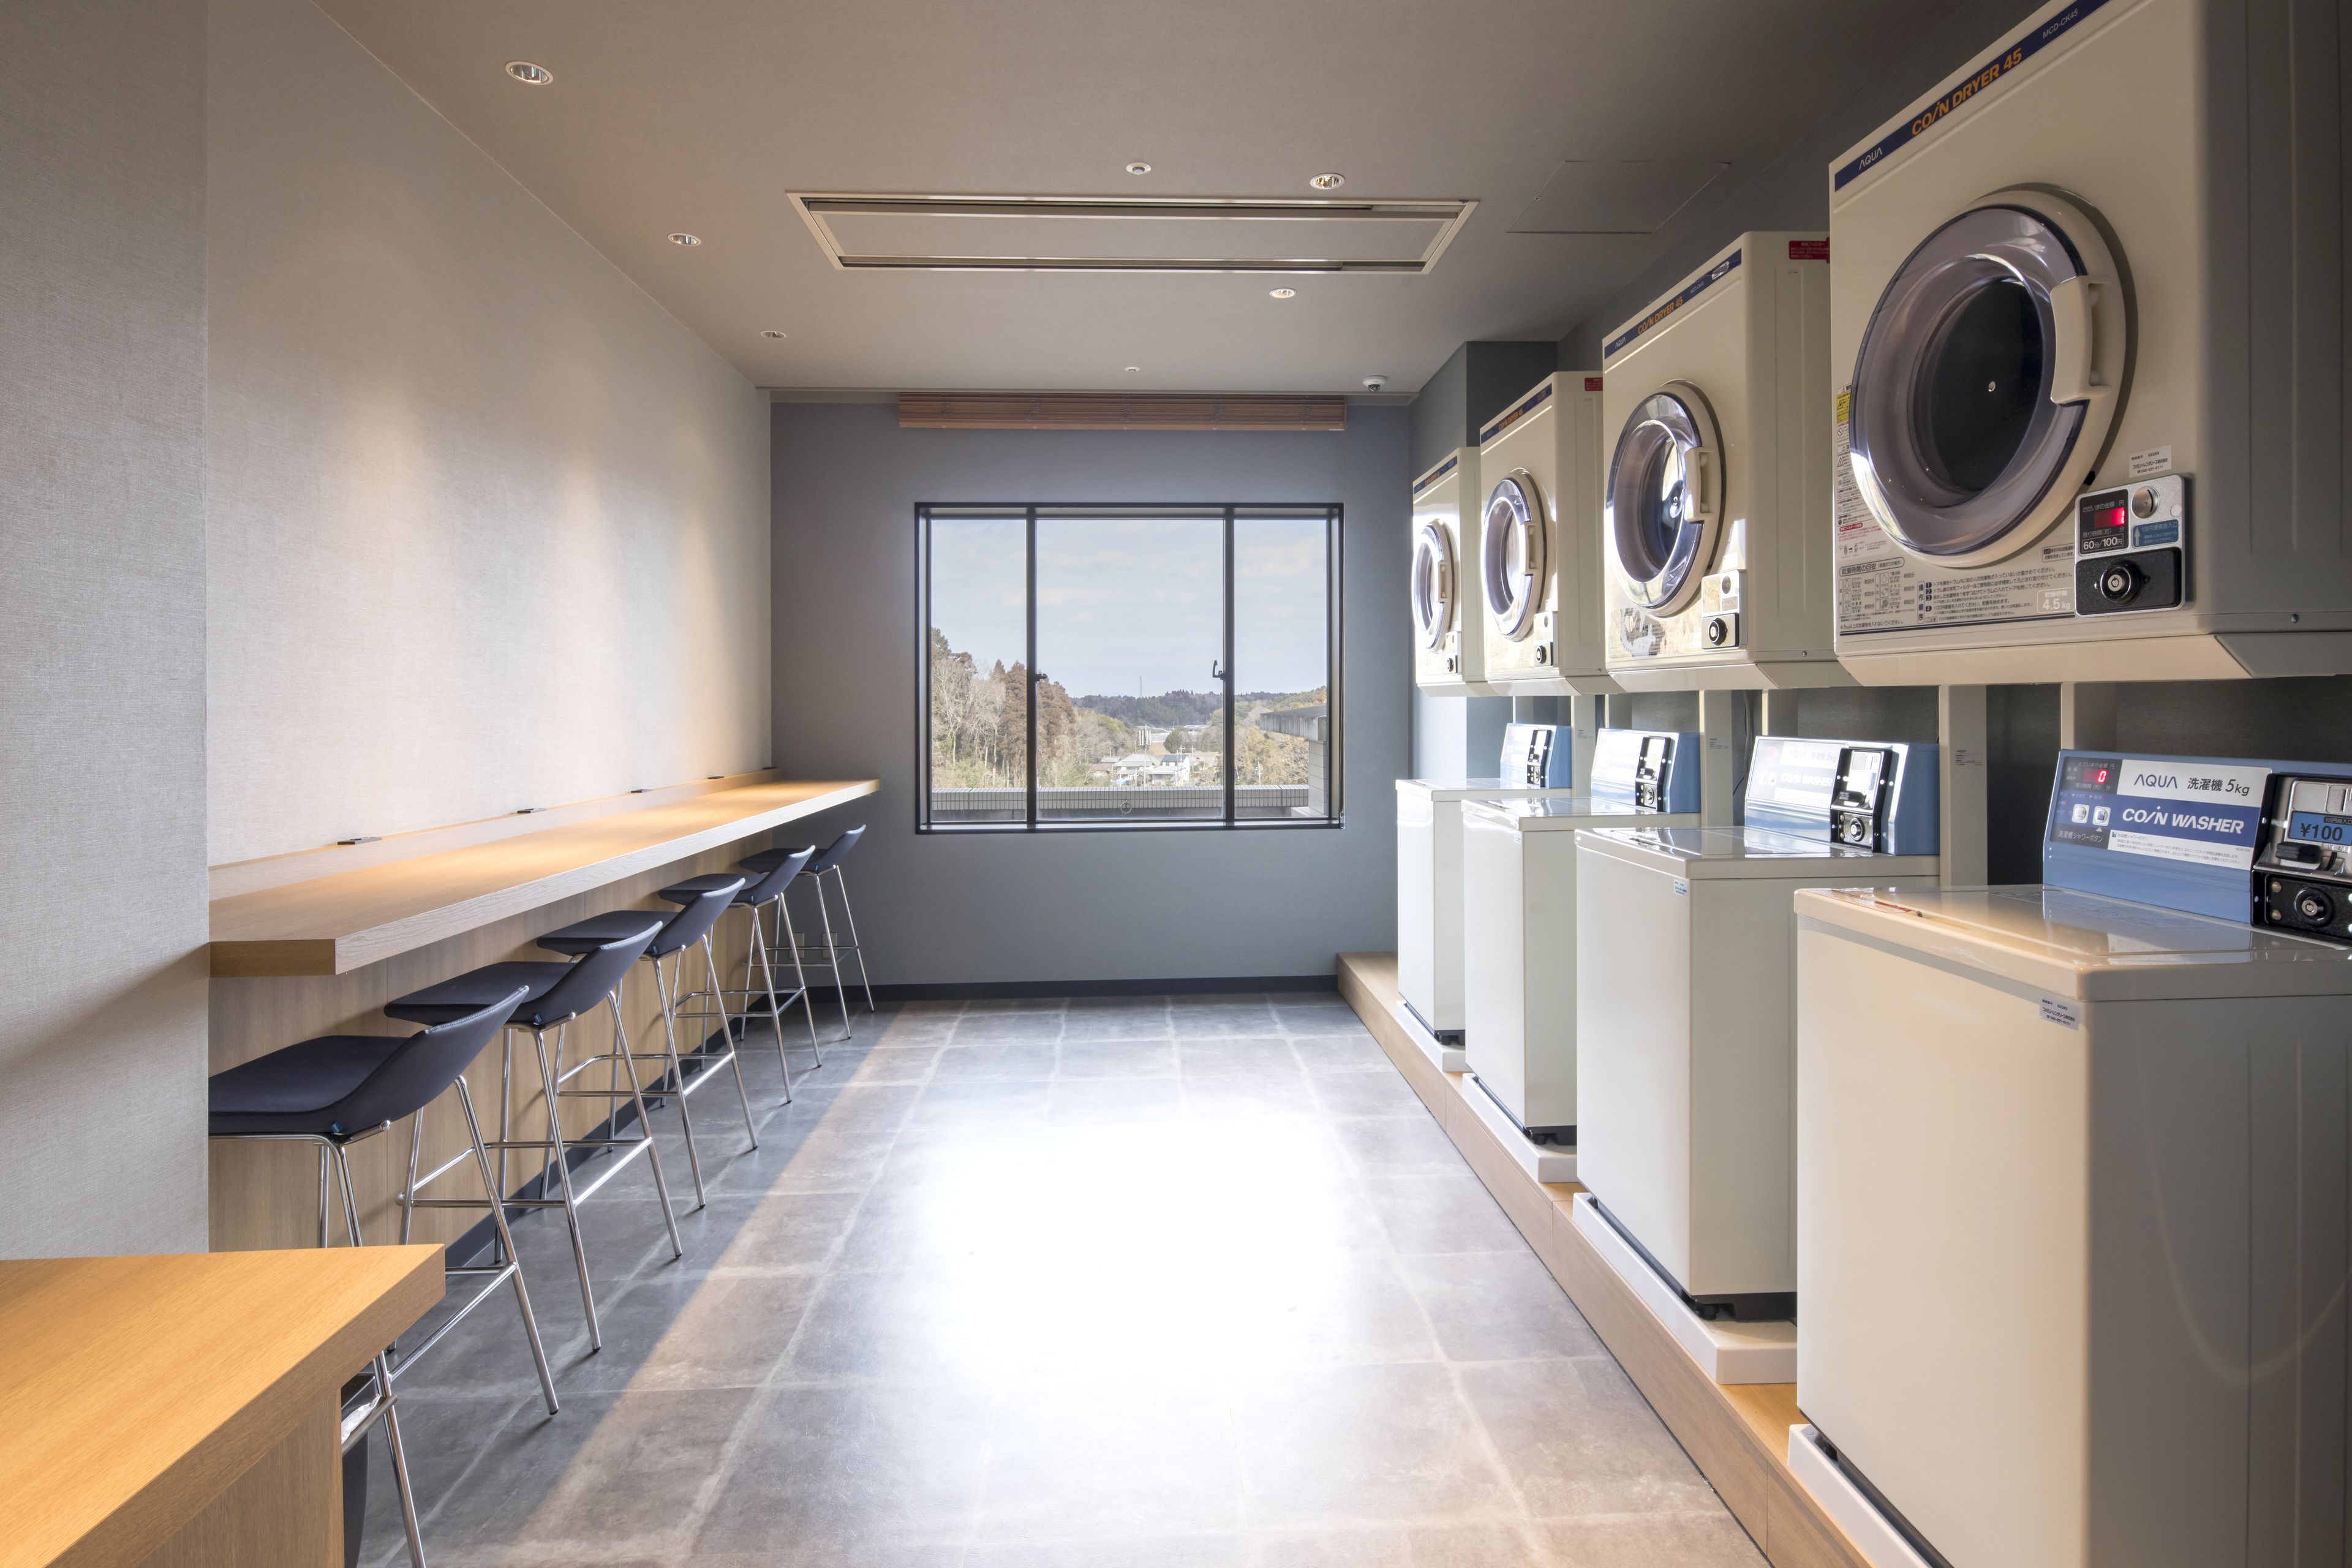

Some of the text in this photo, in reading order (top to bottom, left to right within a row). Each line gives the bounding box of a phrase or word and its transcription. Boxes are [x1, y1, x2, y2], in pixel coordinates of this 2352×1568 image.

[2043, 8, 2078, 39] MCD-CK45
[1952, 63, 2000, 108] DRYER
[2003, 47, 2022, 70] 45
[1858, 147, 1882, 170] AQUA
[1655, 302, 1674, 323] DRYER
[1675, 295, 1683, 307] 45
[1615, 336, 1626, 349] AQUA
[2083, 537, 2123, 550] 60分/100円
[1802, 774, 1833, 787] WASHER
[2097, 770, 2107, 783] 0
[2134, 774, 2250, 796] AQUA 洗濯機 5kg
[2122, 805, 2244, 834] COIN WASHER
[2301, 823, 2343, 841] ¥100
